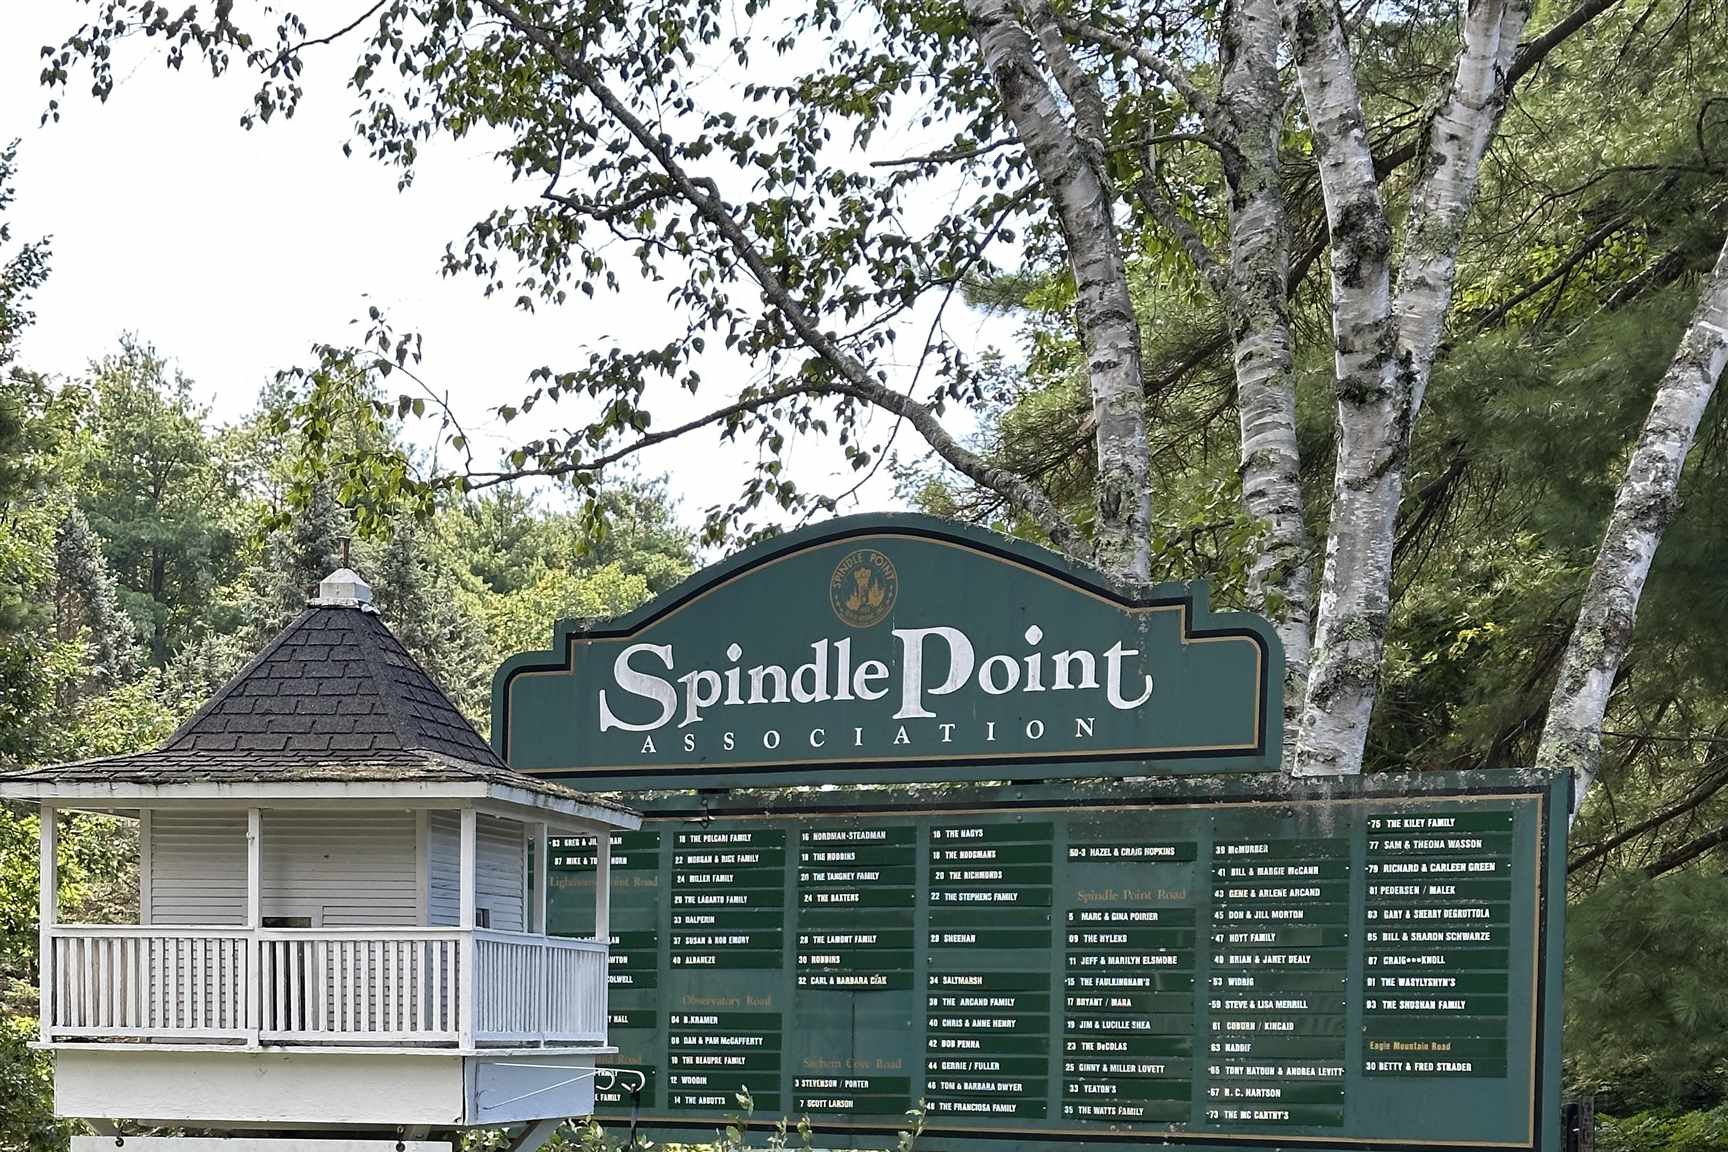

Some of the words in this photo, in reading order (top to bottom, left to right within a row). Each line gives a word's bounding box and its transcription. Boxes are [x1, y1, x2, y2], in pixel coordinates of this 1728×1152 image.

[599, 636, 889, 732] Spindle
[893, 624, 1153, 719] Point
[640, 717, 1096, 754] ASSOCIATION
[1371, 820, 1380, 828] 75
[1404, 819, 1425, 827] KILEY
[1428, 818, 1455, 827] FAMILY
[946, 830, 959, 838] THE
[1370, 841, 1379, 849] 77
[1384, 841, 1402, 849] SAM
[1404, 841, 1410, 849] &
[1414, 840, 1445, 848] THEONA
[1448, 840, 1481, 848] WASSON
[1090, 848, 1111, 856] HAZEL
[1121, 848, 1142, 856] CRAIG
[1216, 846, 1225, 854] 39
[946, 851, 957, 859] THE
[1218, 868, 1225, 876] 41
[1369, 865, 1378, 873] 79
[1384, 864, 1419, 872] RICHARD
[1421, 864, 1427, 872] &
[1430, 863, 1466, 872] CARLEEN
[1468, 863, 1495, 871] GREEN
[677, 875, 684, 883] 24
[1259, 889, 1287, 897] ARLENE
[1381, 886, 1419, 894] PEDERSEN
[1429, 886, 1455, 894] MALEK
[804, 894, 812, 902] 24
[818, 894, 828, 902] THE
[931, 892, 939, 900] 22
[1215, 911, 1223, 919] 45
[1229, 911, 1243, 919] DON
[1254, 911, 1269, 919] JILL
[1414, 910, 1441, 918] SHERRY
[855, 935, 876, 943] FAMILY
[1215, 934, 1224, 942] 47
[1230, 934, 1248, 942] HOYT
[1251, 933, 1275, 941] FAMILY
[1383, 933, 1398, 941] BILL
[1402, 933, 1408, 941] &
[1411, 933, 1443, 941] SHARON
[1446, 932, 1490, 940] SCHWARZE
[1069, 957, 1076, 965] 11
[1081, 957, 1098, 965] JEFF
[1081, 978, 1092, 986] THE
[1381, 978, 1395, 986] THE
[943, 998, 955, 1006] THE
[990, 998, 1014, 1006] FAMILY
[1250, 1000, 1255, 1008] &
[1276, 1000, 1307, 1008] MERRILL
[1383, 1001, 1396, 1009] THE
[1439, 1001, 1465, 1009] FAMILY
[1102, 1021, 1129, 1029] LUCILLE
[1132, 1021, 1150, 1029] SHEA
[721, 1037, 762, 1045] McCAFFERTY
[1067, 1042, 1076, 1050] 23
[1082, 1042, 1094, 1050] THE
[1394, 1042, 1428, 1050] Mountain
[1432, 1042, 1450, 1050] Road
[975, 1062, 999, 1070] FULLER
[1138, 1065, 1164, 1073] LOVETT
[1366, 1062, 1376, 1070] 30
[1379, 1062, 1402, 1070] BETTY
[1406, 1062, 1411, 1070] &
[1415, 1063, 1433, 1071] FRED
[1437, 1063, 1471, 1071] STRADER
[1319, 1068, 1344, 1076] LEVITT
[998, 1083, 1022, 1091] DWYER
[1235, 1088, 1243, 1096] C.
[685, 1096, 696, 1104] THE
[993, 1104, 1016, 1112] FAMILY
[1079, 1106, 1091, 1114] THE
[1119, 1107, 1143, 1115] FAMILY
[1210, 1110, 1218, 1118] 73
